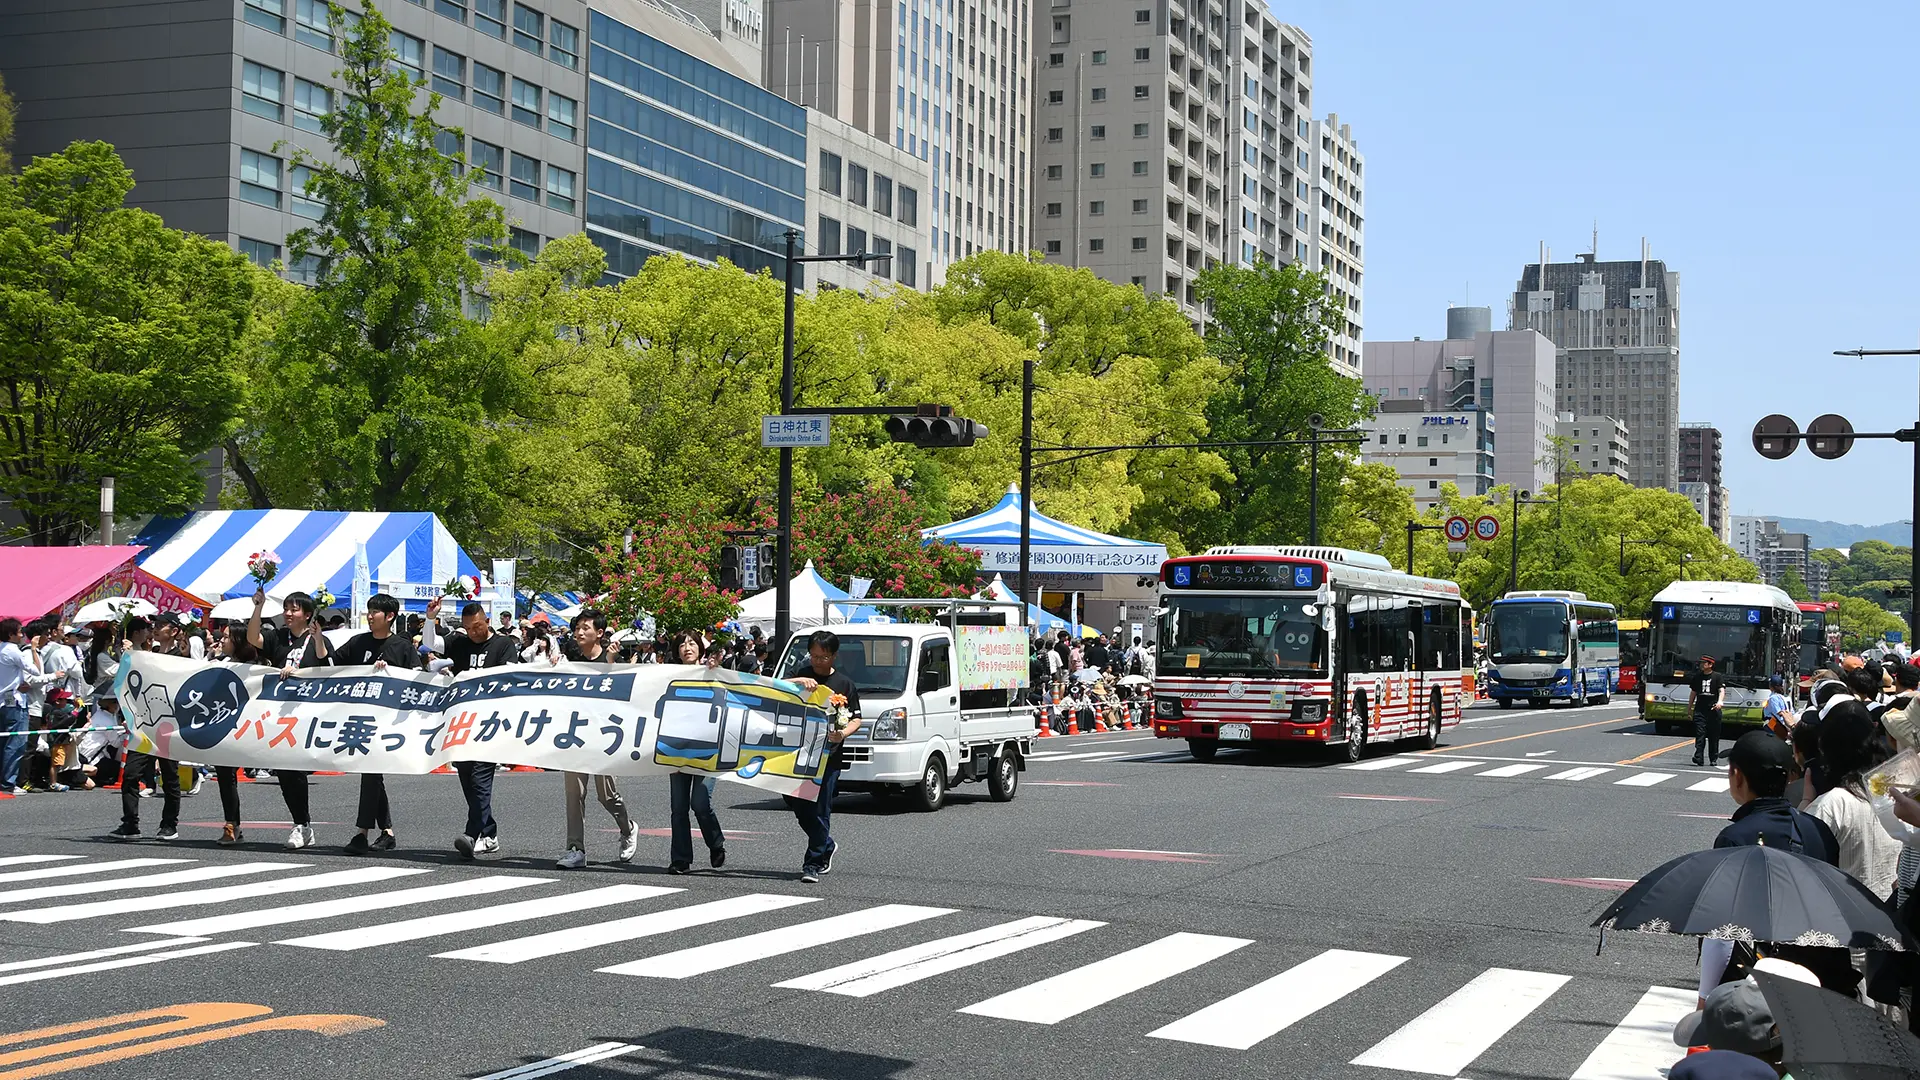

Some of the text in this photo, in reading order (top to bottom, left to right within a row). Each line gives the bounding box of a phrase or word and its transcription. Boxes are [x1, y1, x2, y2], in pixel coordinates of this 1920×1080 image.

[1422, 416, 1469, 426] アサヒホーム
[769, 419, 822, 434] 白神社東
[797, 434, 811, 442] Shrine
[812, 434, 822, 442] East
[1479, 522, 1494, 534] 50
[995, 551, 1159, 566] 修道園300周年記念ひろば
[1221, 565, 1270, 574] 広島バス
[1213, 575, 1279, 583] フラワーフェスティバル
[233, 708, 647, 761] バスに乗って出かけよう!
[1238, 728, 1250, 738] 70
